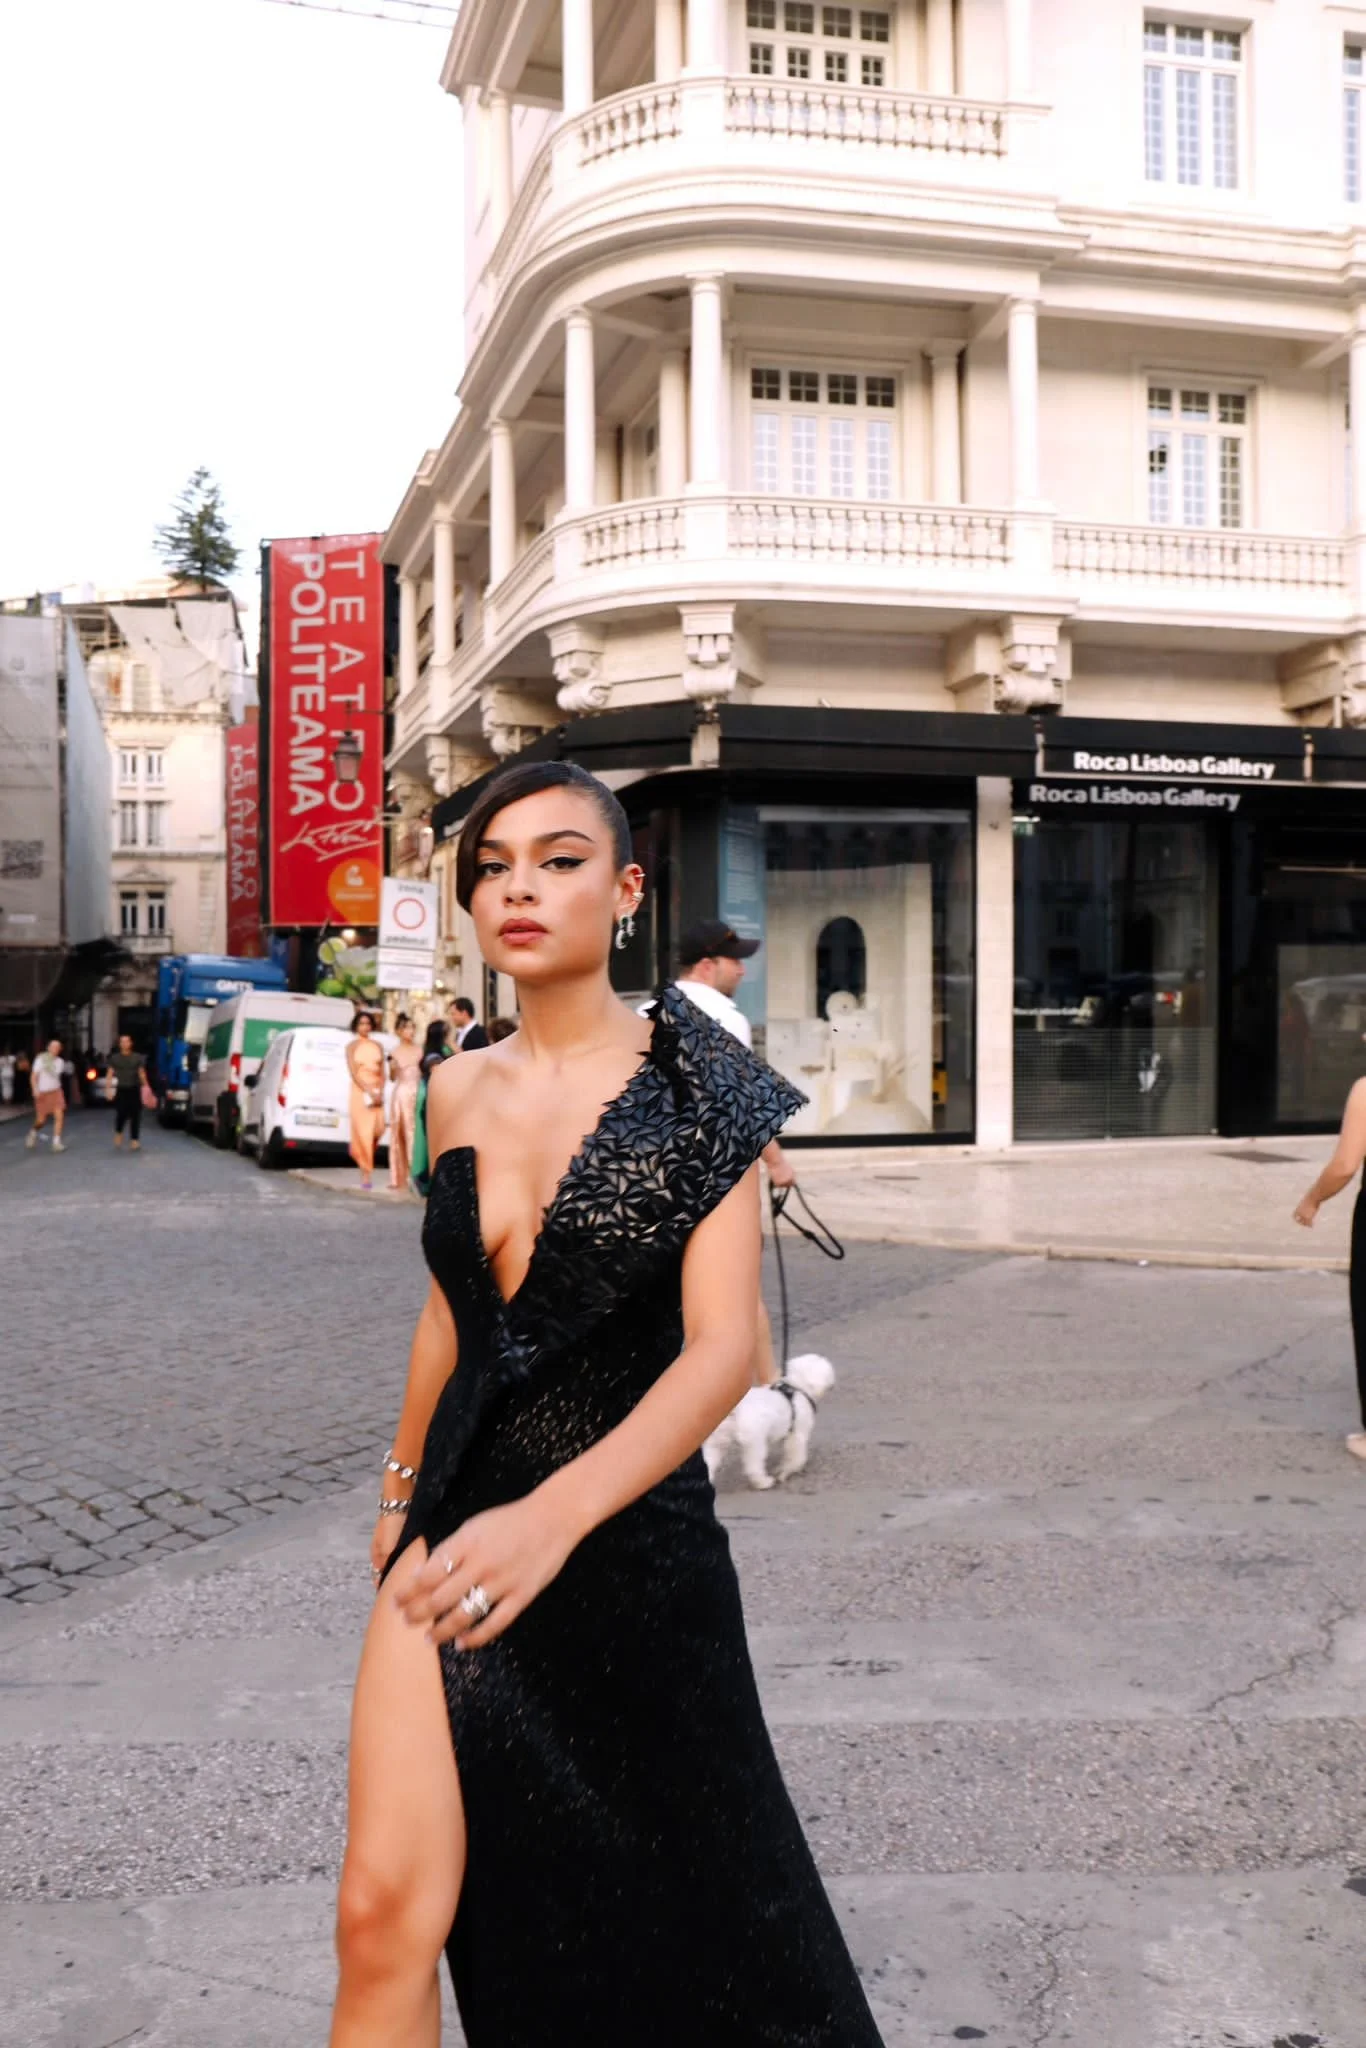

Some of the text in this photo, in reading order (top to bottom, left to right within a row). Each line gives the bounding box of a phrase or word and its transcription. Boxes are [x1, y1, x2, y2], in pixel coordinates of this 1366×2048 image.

[289, 553, 326, 816] POLITEAMA
[231, 743, 245, 900] POLITEAMA
[244, 743, 257, 898] TEATRO
[1029, 784, 1241, 812] Roca Lisboa Gallery
[1073, 751, 1276, 780] Roca Lisboa Gallery
